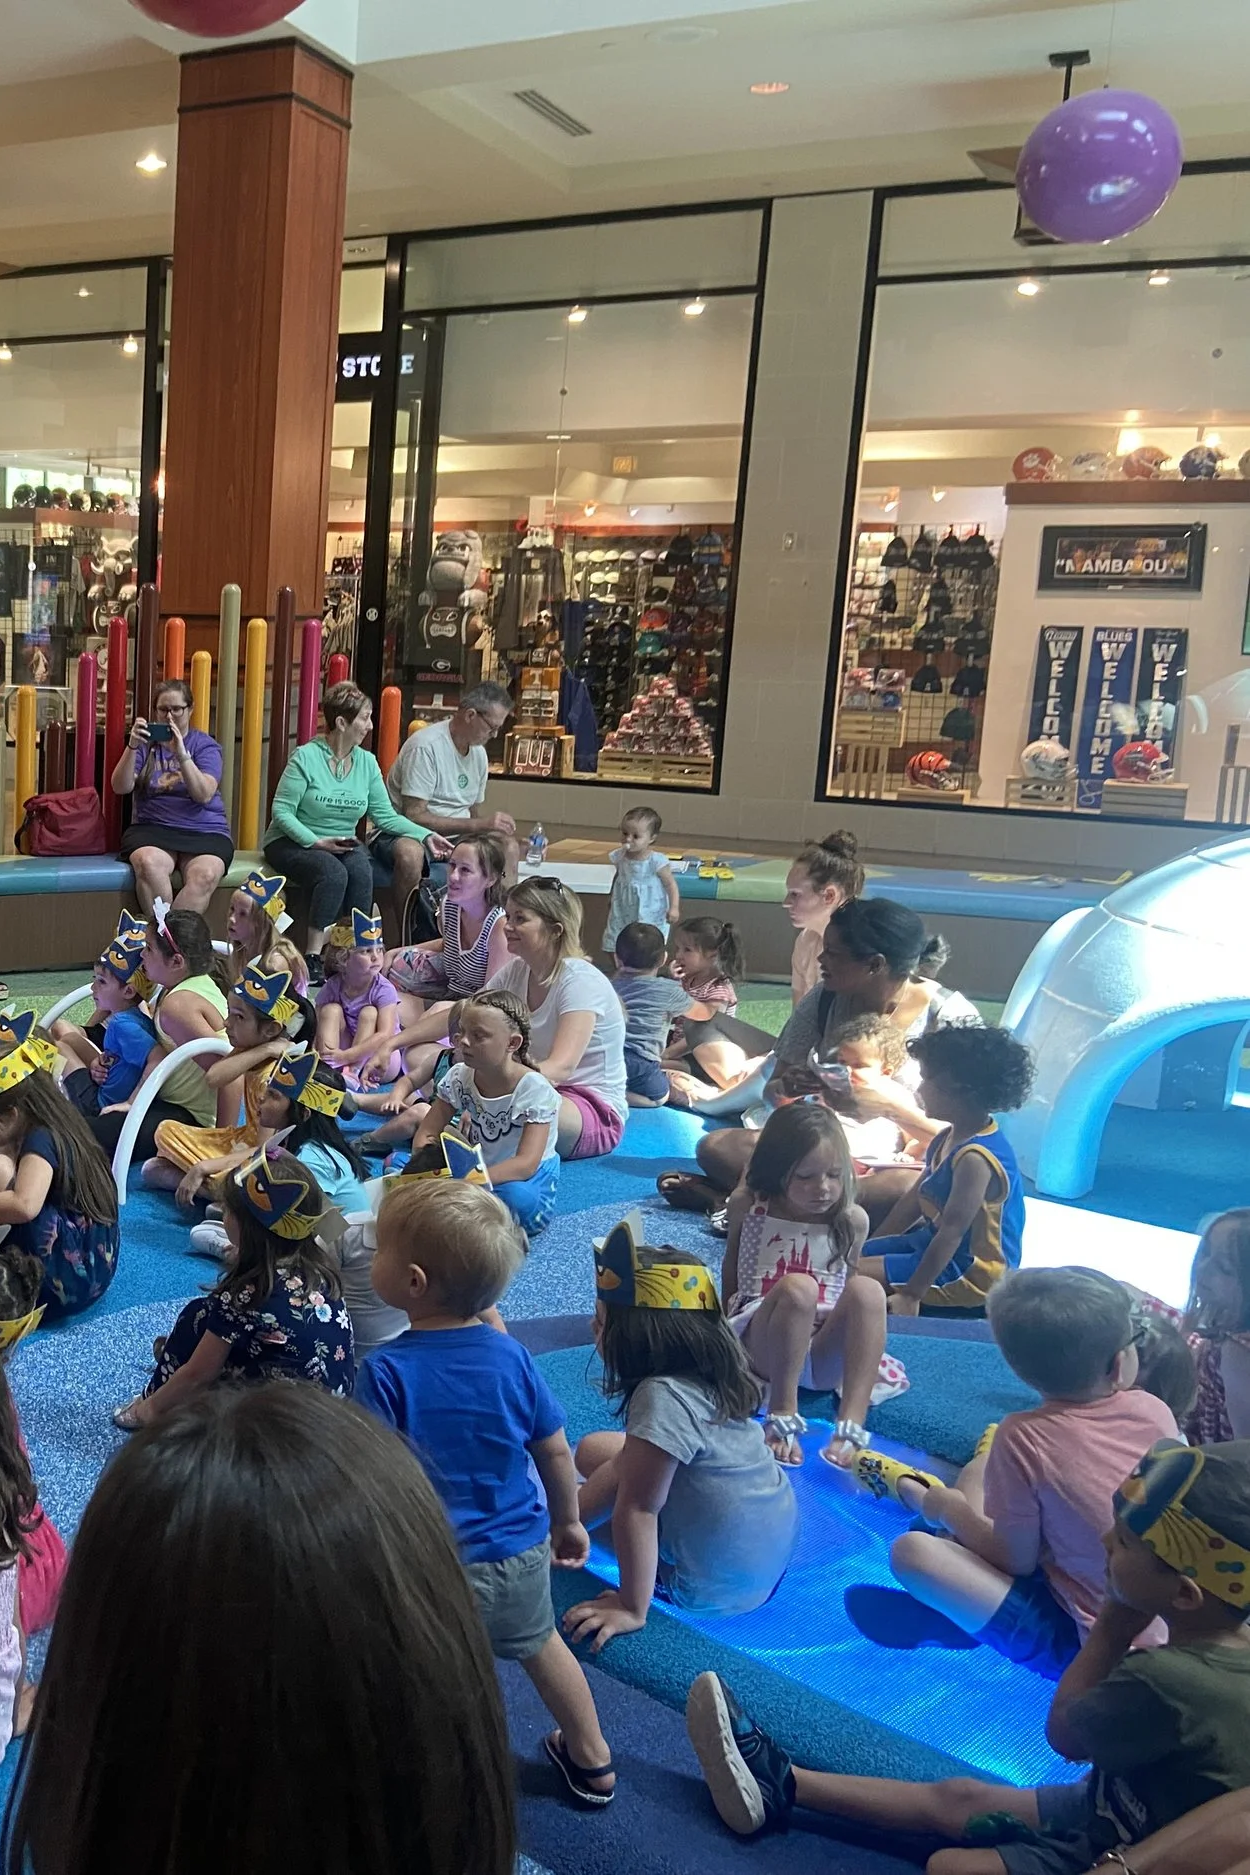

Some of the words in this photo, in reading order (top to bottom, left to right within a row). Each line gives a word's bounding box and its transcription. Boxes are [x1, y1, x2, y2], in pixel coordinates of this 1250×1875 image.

[342, 355, 415, 378] STOE
[1096, 632, 1133, 642] BLUES
[1040, 642, 1072, 740] WELCO
[1090, 643, 1127, 774] WELCOME
